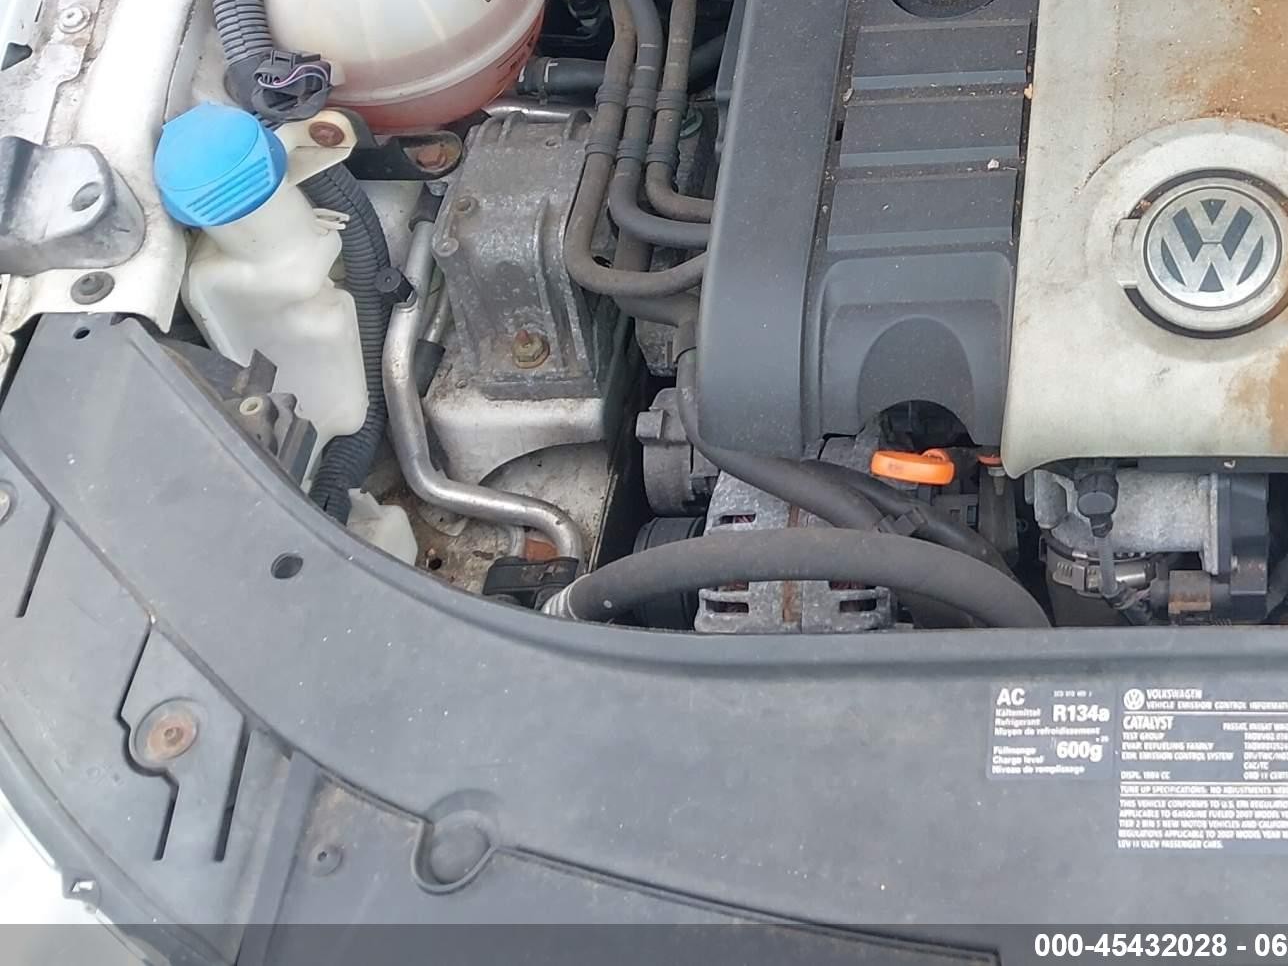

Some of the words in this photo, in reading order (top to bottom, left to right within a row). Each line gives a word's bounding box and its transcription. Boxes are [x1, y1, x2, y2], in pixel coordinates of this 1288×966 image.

[997, 688, 1025, 706] AC
[1146, 689, 1203, 700] VOLKSWAGEN
[1053, 704, 1110, 722] R134a
[1146, 701, 1174, 709] VEHICLE
[1123, 716, 1174, 730] CATALYST
[1056, 741, 1103, 762] 600g
